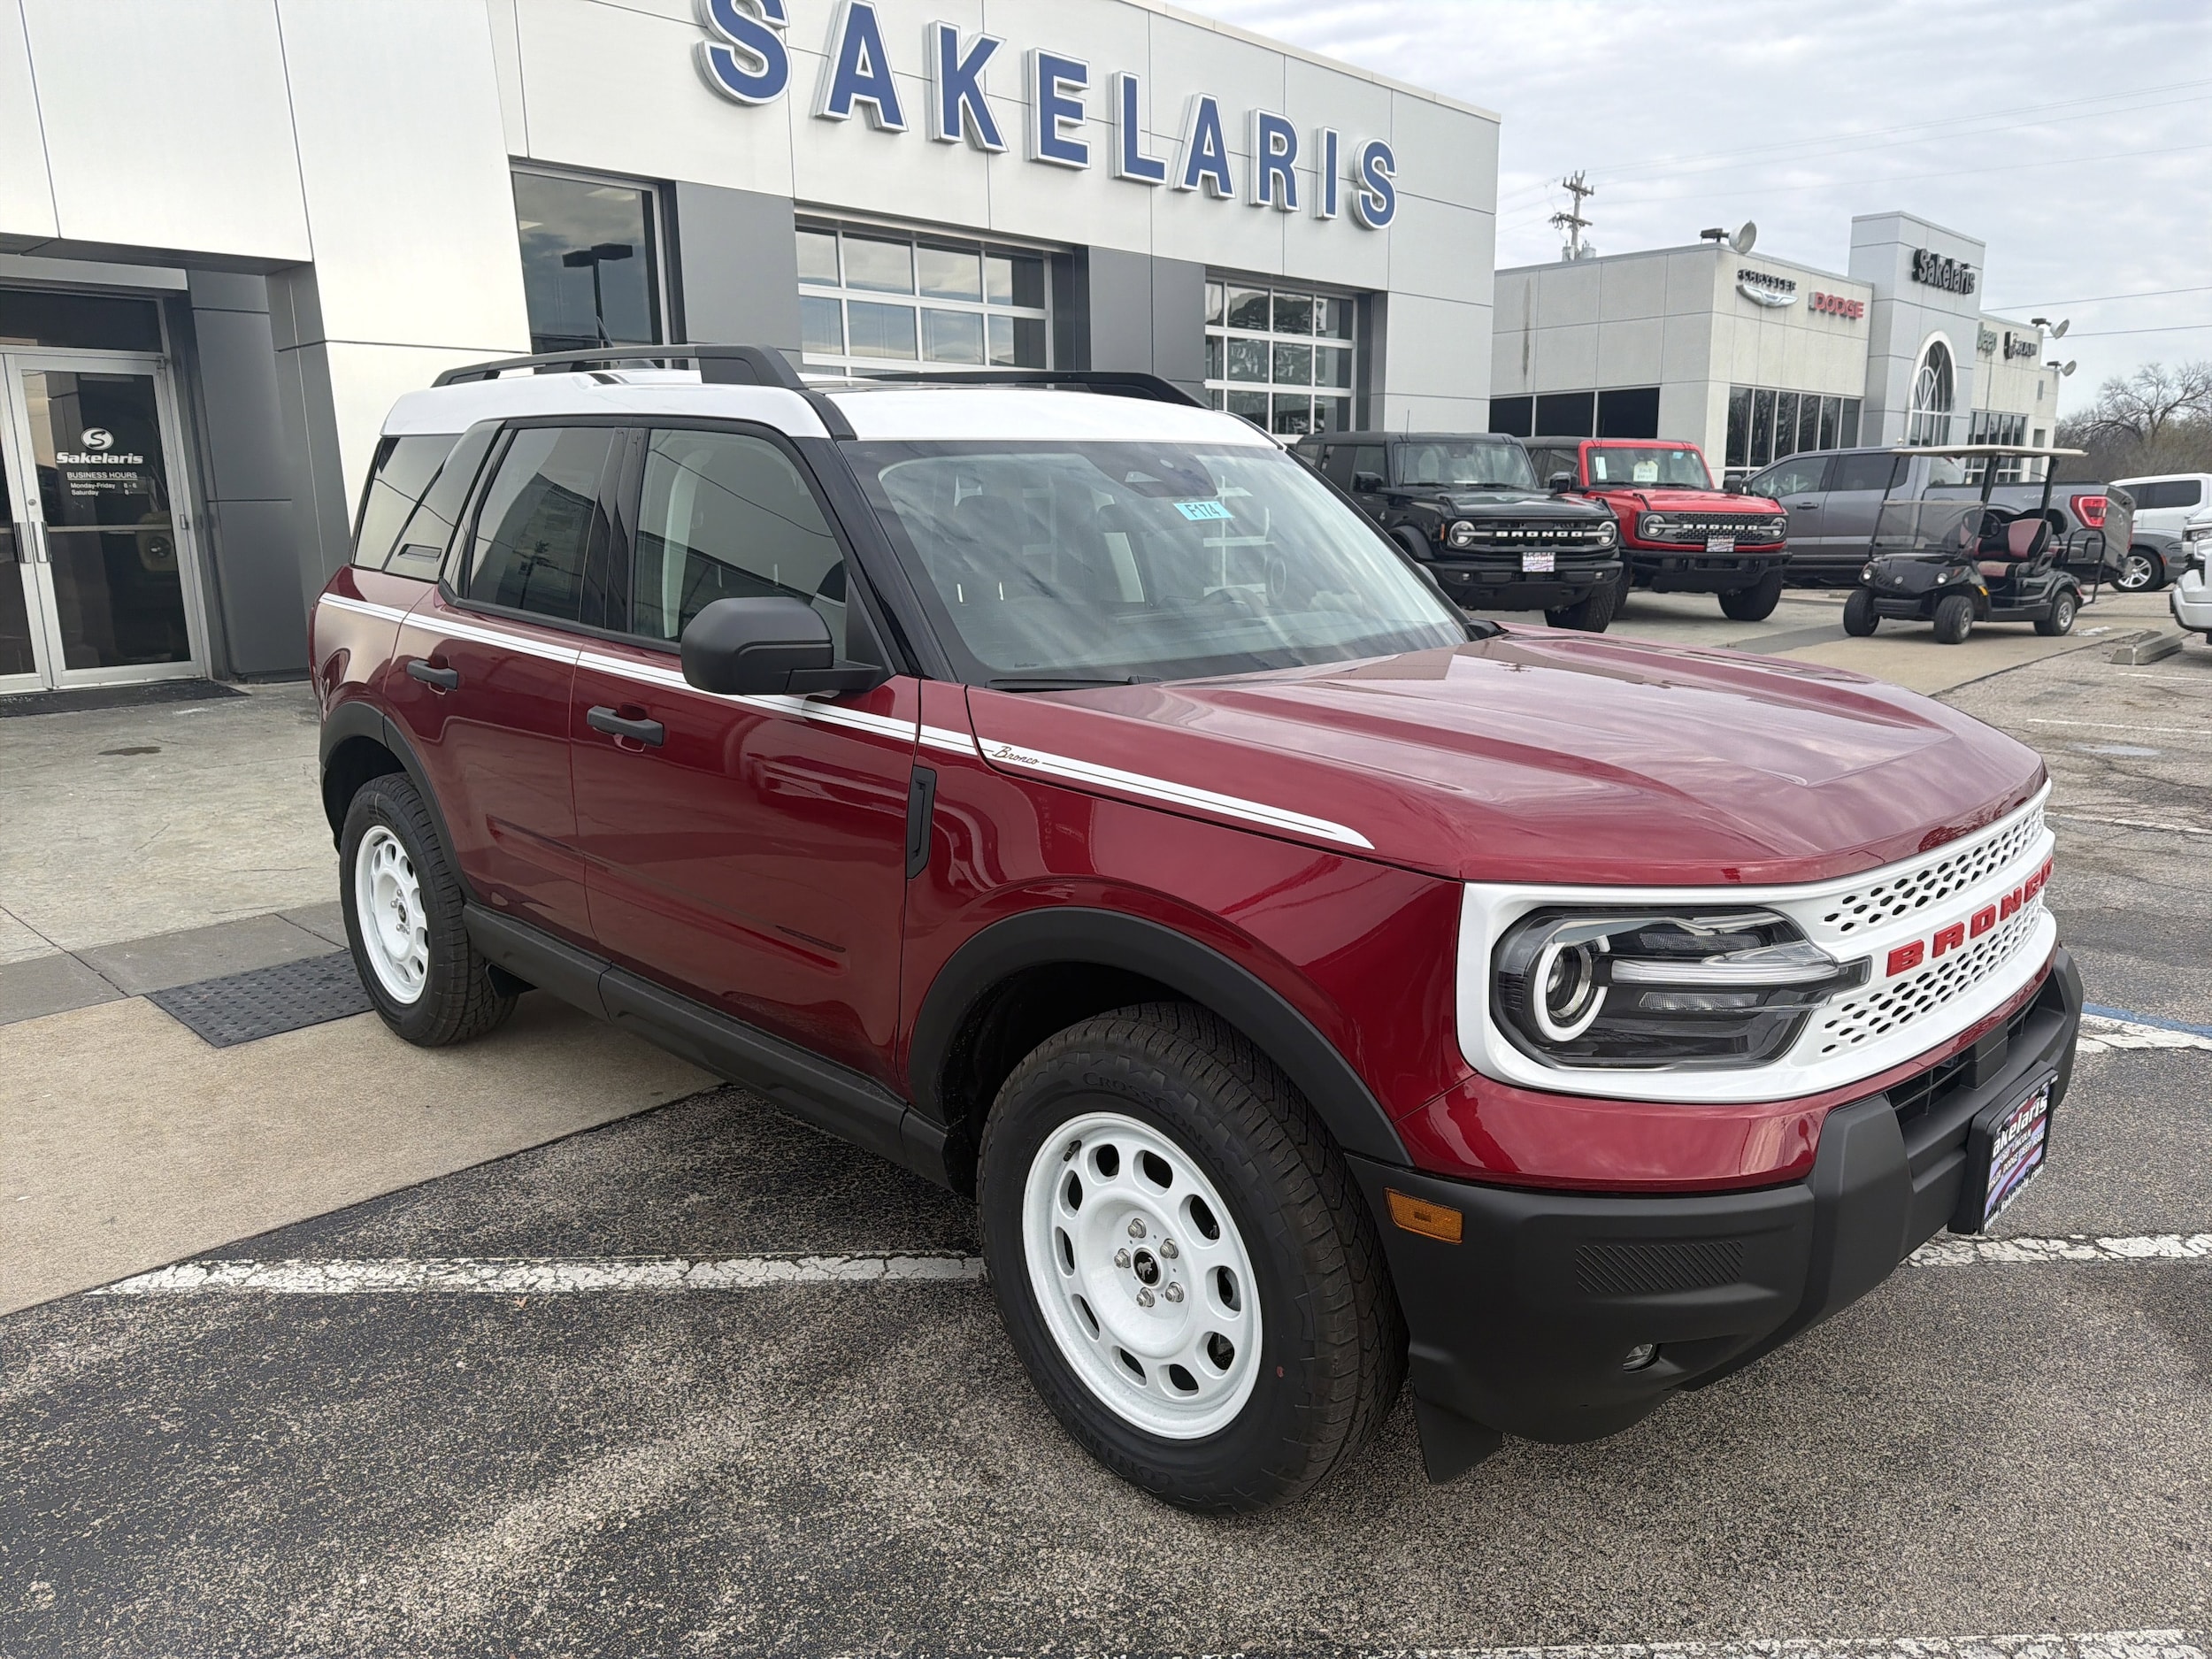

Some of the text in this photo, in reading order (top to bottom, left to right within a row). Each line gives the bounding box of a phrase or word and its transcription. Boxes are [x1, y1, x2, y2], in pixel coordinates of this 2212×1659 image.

[697, 0, 1398, 231] SAKELARIS
[1912, 249, 1976, 295] Sakelaris
[1809, 291, 1865, 319] DODGE
[56, 452, 143, 465] Sakelaris
[1184, 503, 1222, 518] F174
[992, 745, 1041, 765] Bronco
[1886, 855, 2055, 978] BRONCO
[1993, 1094, 2048, 1158] akelaris
